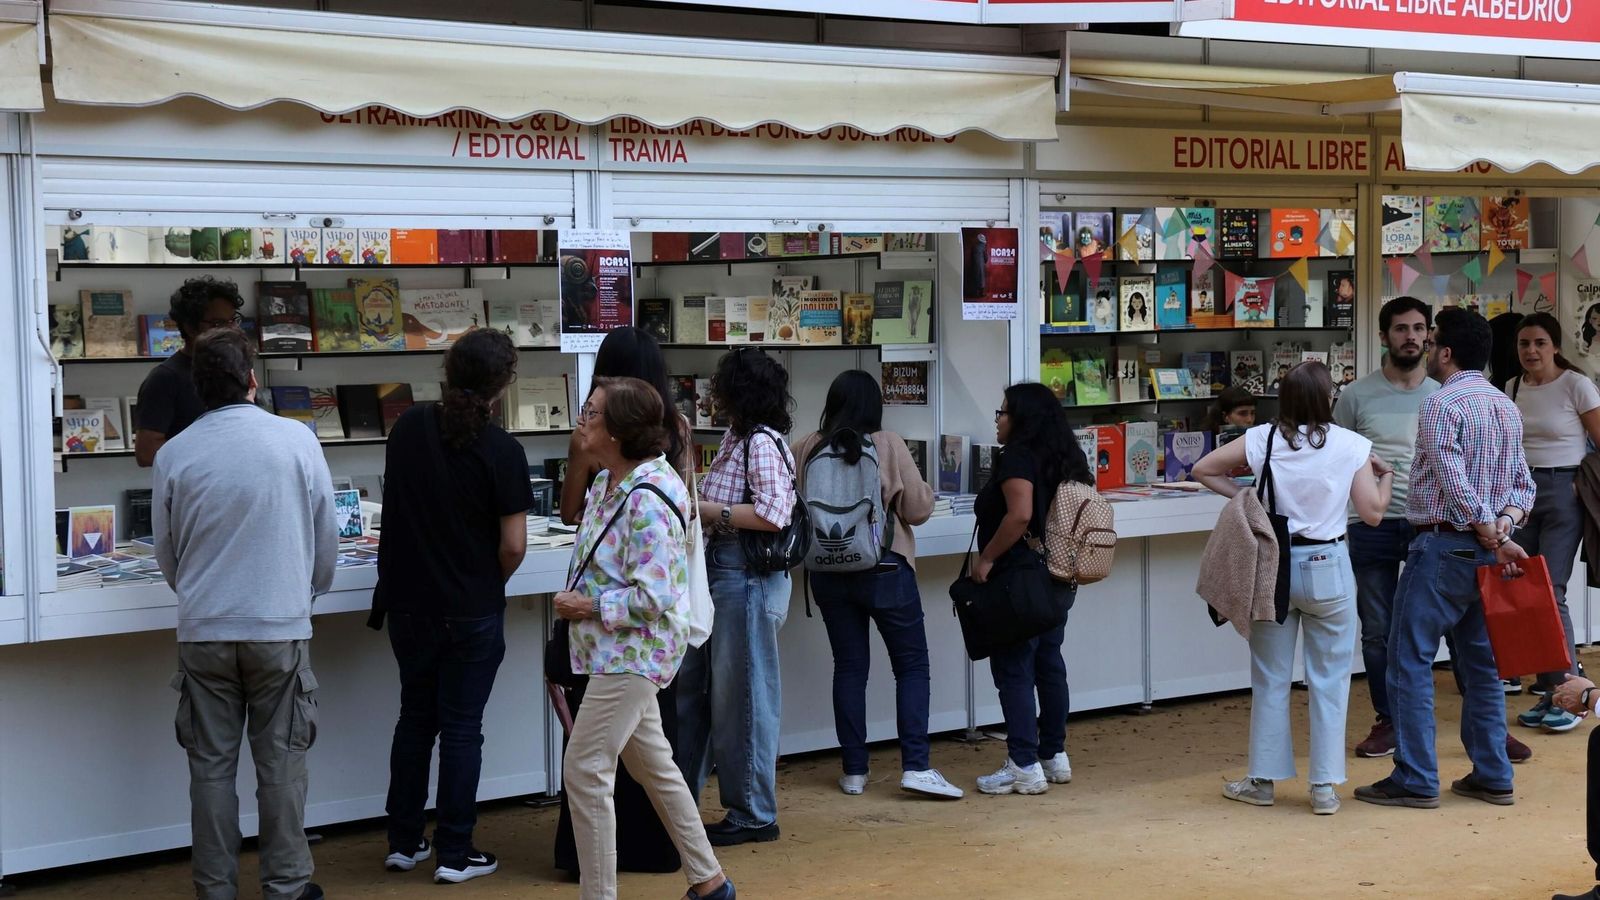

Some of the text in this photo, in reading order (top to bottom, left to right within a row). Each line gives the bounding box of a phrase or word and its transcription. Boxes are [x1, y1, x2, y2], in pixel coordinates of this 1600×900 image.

[1461, 0, 1573, 23] ALBEDRIO
[469, 133, 586, 160] EDTORIAL
[609, 138, 688, 163] TRAMA
[1174, 137, 1300, 169] EDITORIAL
[1307, 140, 1368, 170] LIBRE
[1386, 233, 1412, 242] LOBA
[893, 367, 918, 377] BIZUM
[815, 552, 862, 565] adidas
